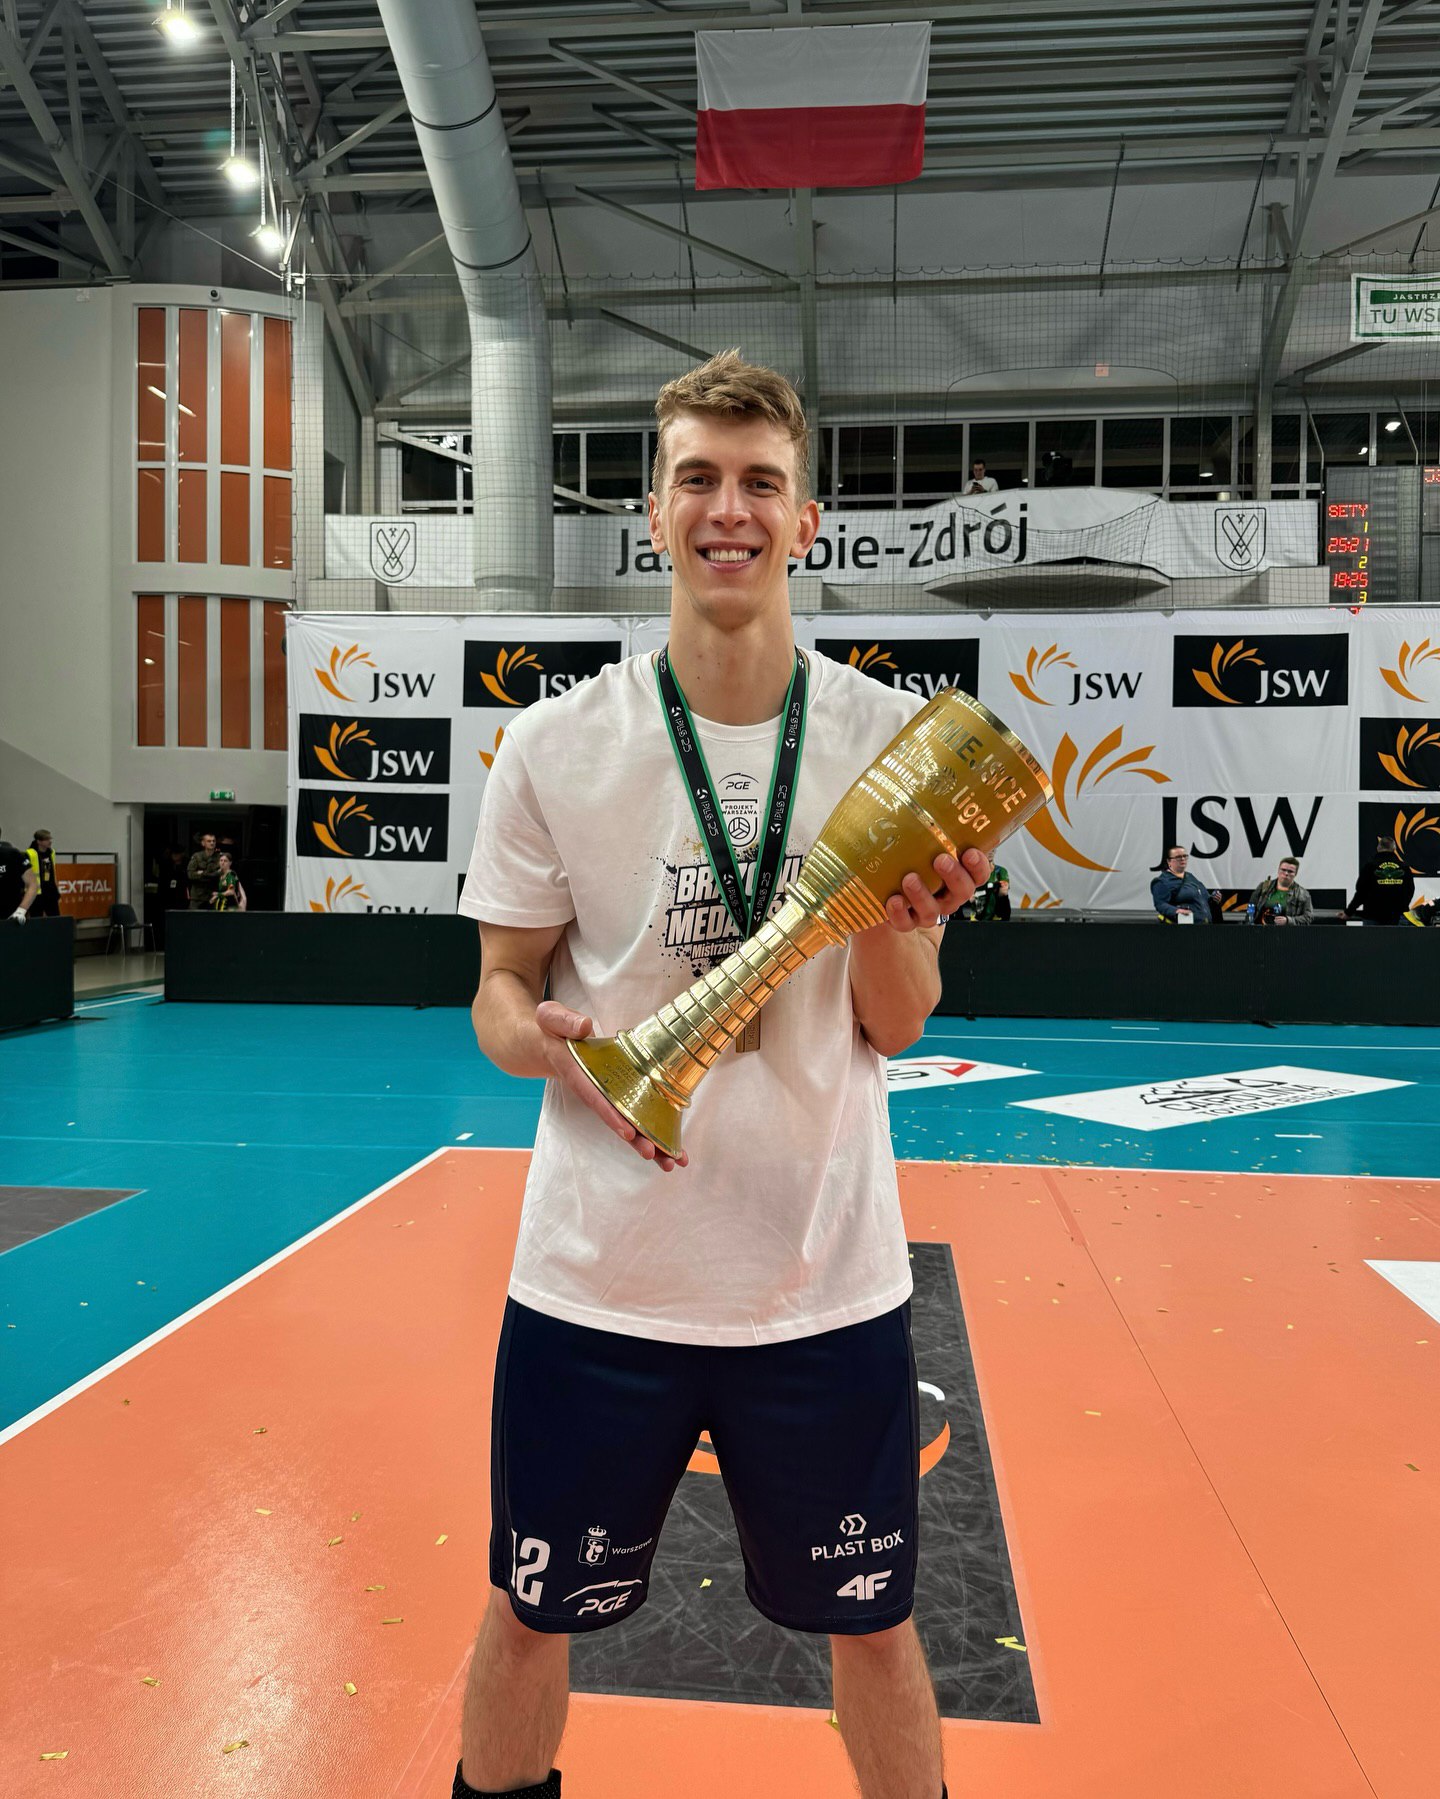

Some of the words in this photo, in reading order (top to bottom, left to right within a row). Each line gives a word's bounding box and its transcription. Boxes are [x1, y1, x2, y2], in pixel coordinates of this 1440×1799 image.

[1370, 308, 1397, 324] TU
[1405, 307, 1440, 323] WS
[1328, 504, 1368, 518] SETY
[615, 502, 1029, 577] Jabie-Zdrój
[1363, 521, 1369, 533] 1
[1328, 537, 1370, 553] 25:21
[1358, 556, 1368, 569] 2
[1333, 572, 1368, 588] 19:25
[1359, 591, 1367, 604] 3
[369, 672, 436, 703] JSW
[1068, 672, 1143, 706] JSW
[1255, 669, 1330, 704] JSW
[367, 750, 434, 781] JSW
[934, 718, 1027, 814] MIEJSCE
[725, 781, 751, 790] PGE
[364, 825, 433, 858] JSW
[1149, 795, 1325, 872] JSW
[58, 880, 112, 894] EXTRAL
[1159, 1084, 1330, 1112] CAROLINA
[811, 1540, 866, 1562] PLAST
[870, 1529, 904, 1553] BOX
[836, 1569, 893, 1600] 4F
[577, 1590, 632, 1616] PGE
